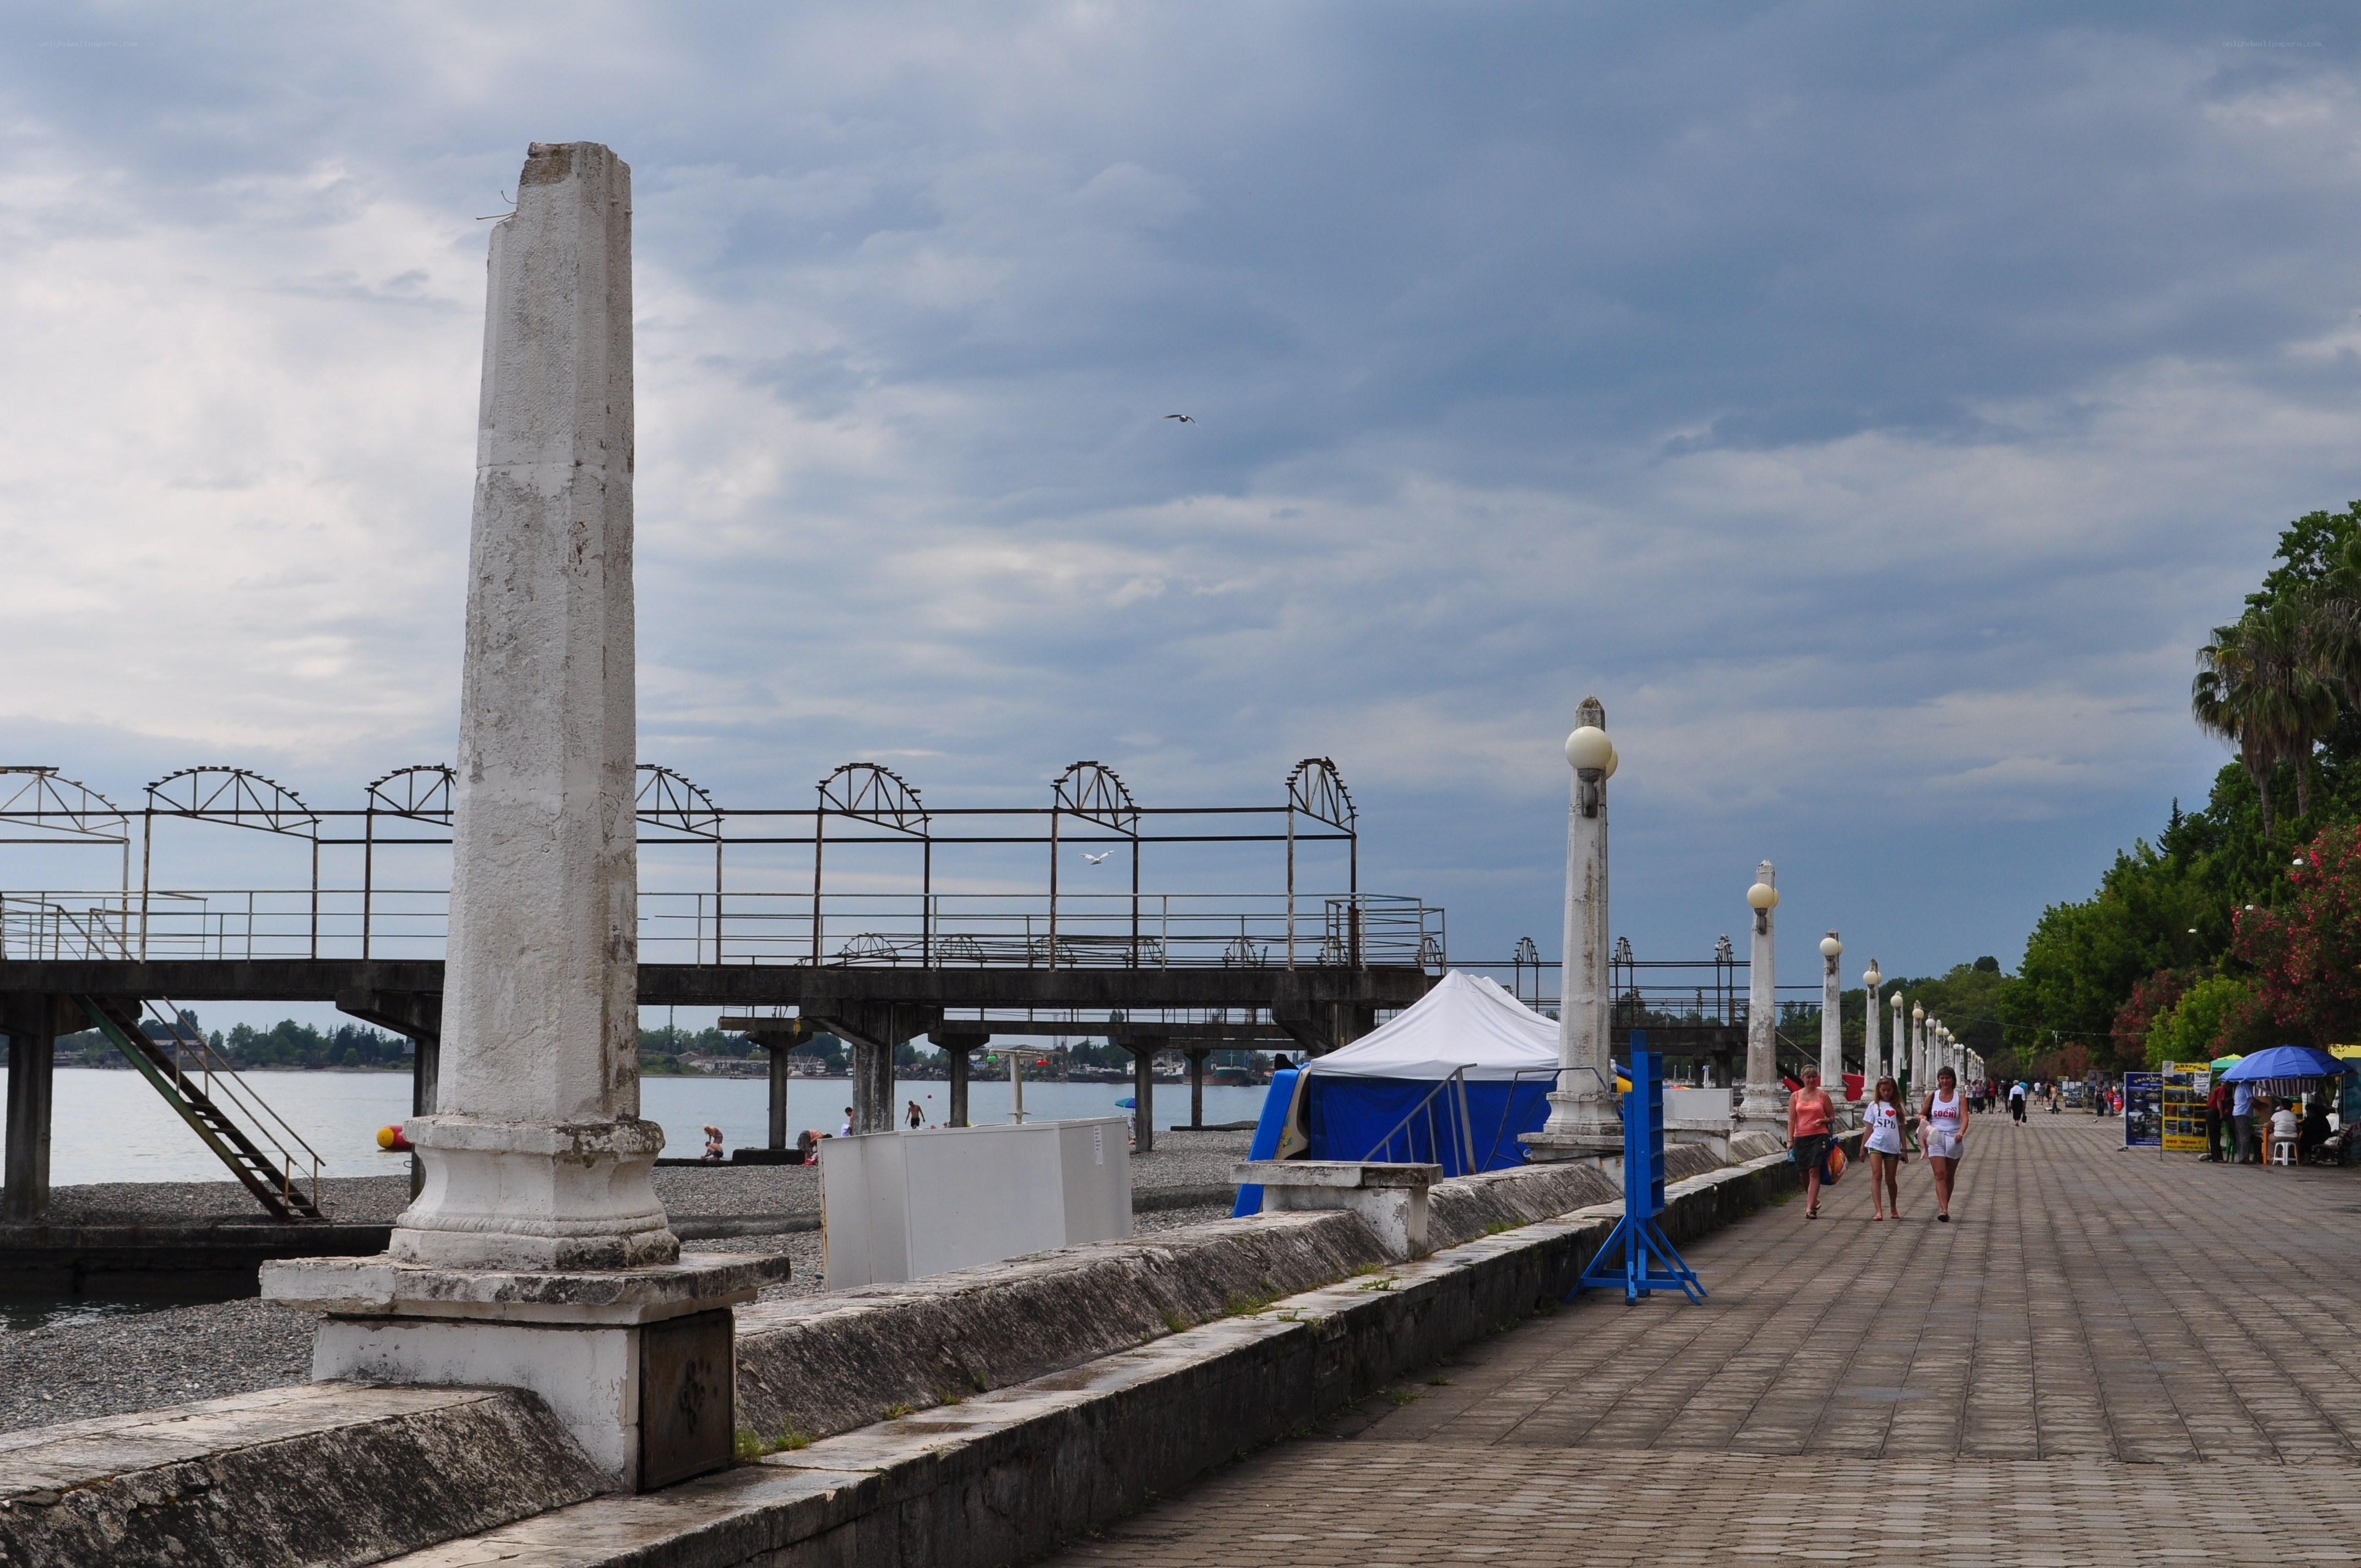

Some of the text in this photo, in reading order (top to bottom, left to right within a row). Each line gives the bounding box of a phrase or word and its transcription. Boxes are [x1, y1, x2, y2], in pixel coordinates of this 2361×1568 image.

[1878, 1109, 1881, 1117] I
[1933, 1110, 1956, 1119] SOCHI
[1877, 1118, 1896, 1129] SPb
